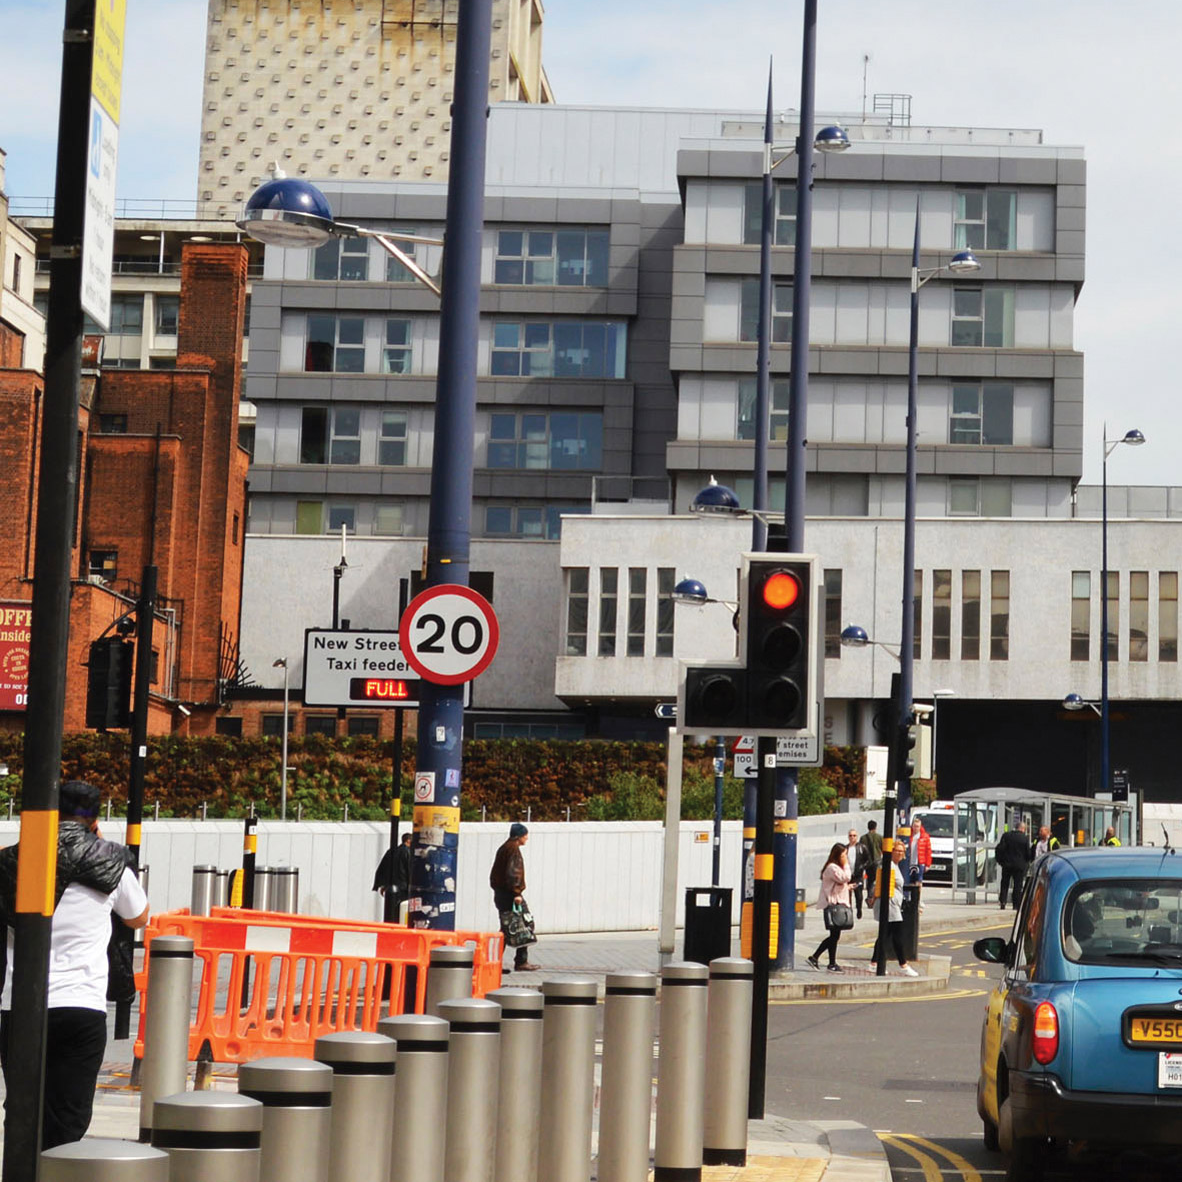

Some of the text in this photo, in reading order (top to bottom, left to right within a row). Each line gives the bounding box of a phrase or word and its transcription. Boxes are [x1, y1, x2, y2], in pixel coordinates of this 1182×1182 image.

[416, 613, 484, 655] 20
[314, 637, 348, 650] New
[327, 658, 357, 670] Taxi
[365, 679, 409, 698] FULL
[783, 741, 809, 749] street
[736, 755, 752, 763] 100
